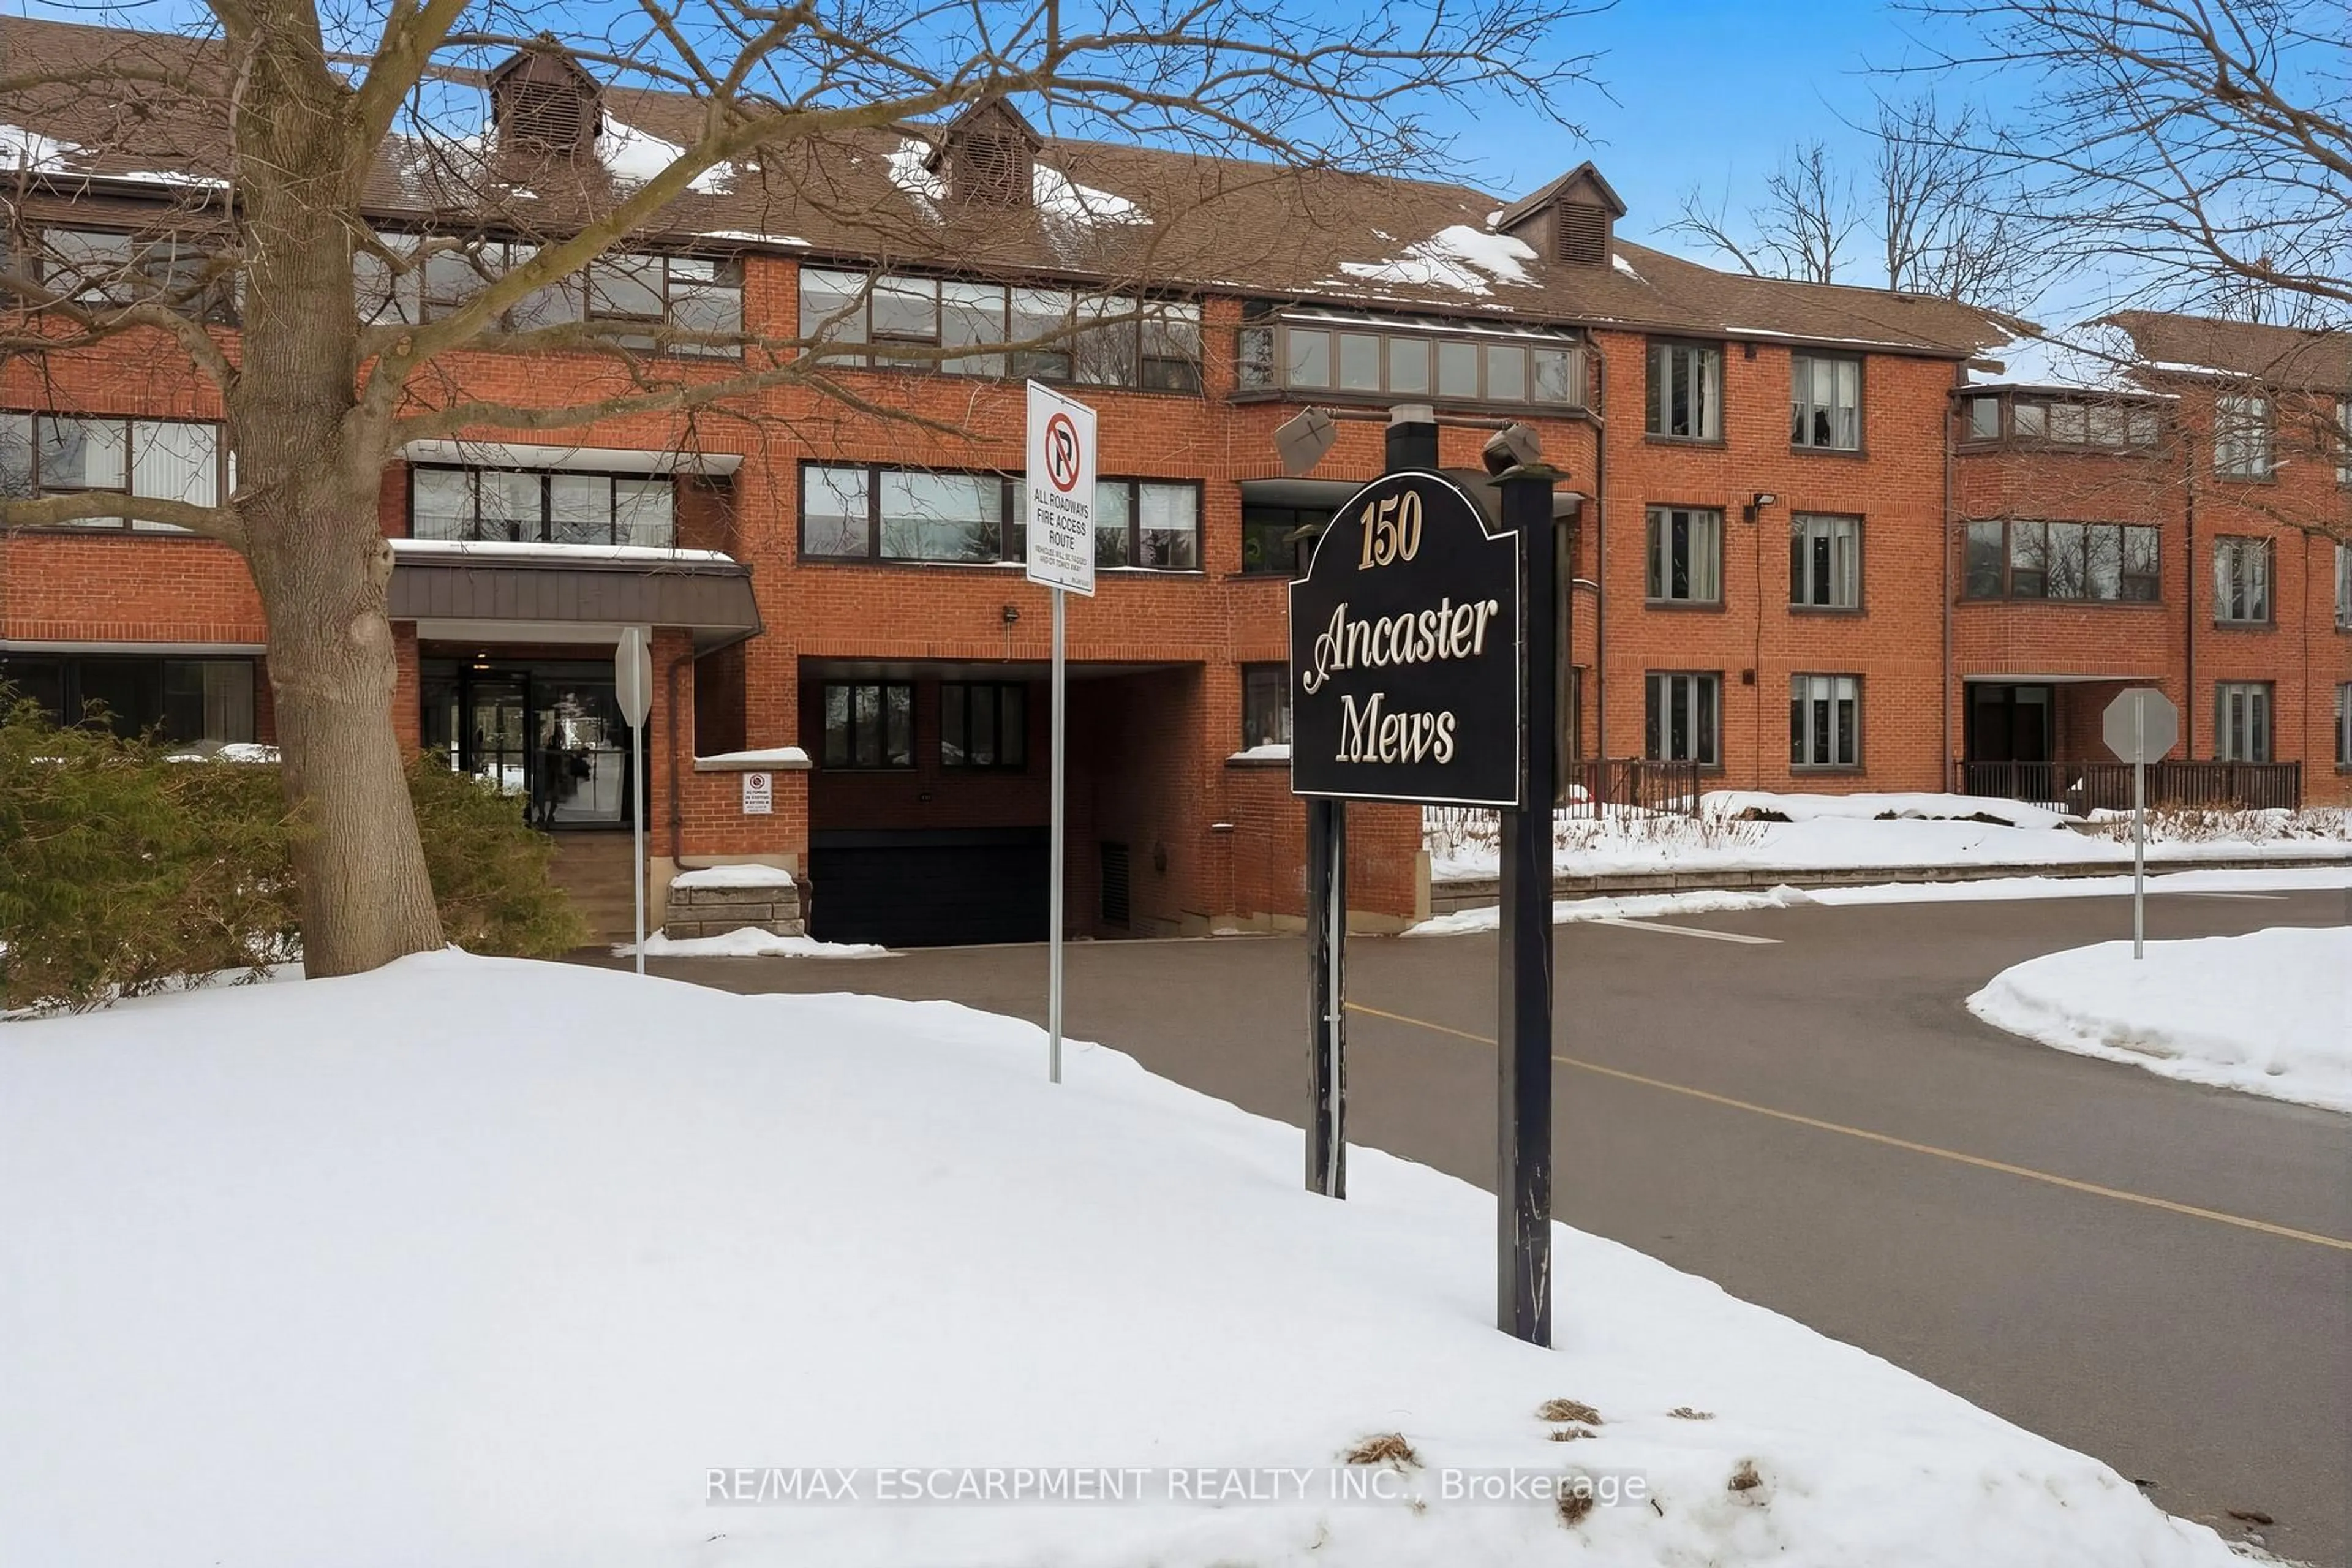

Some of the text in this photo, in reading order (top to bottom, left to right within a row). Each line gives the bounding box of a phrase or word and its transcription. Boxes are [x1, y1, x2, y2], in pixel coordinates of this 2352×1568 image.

[1034, 488, 1089, 519] ALL ROADWAYS
[1037, 508, 1087, 537] FIRE ACCESS
[1049, 530, 1075, 550] ROUTE
[1358, 489, 1422, 570] 150
[1303, 597, 1498, 695] Ancaster
[1335, 692, 1457, 764] Mews
